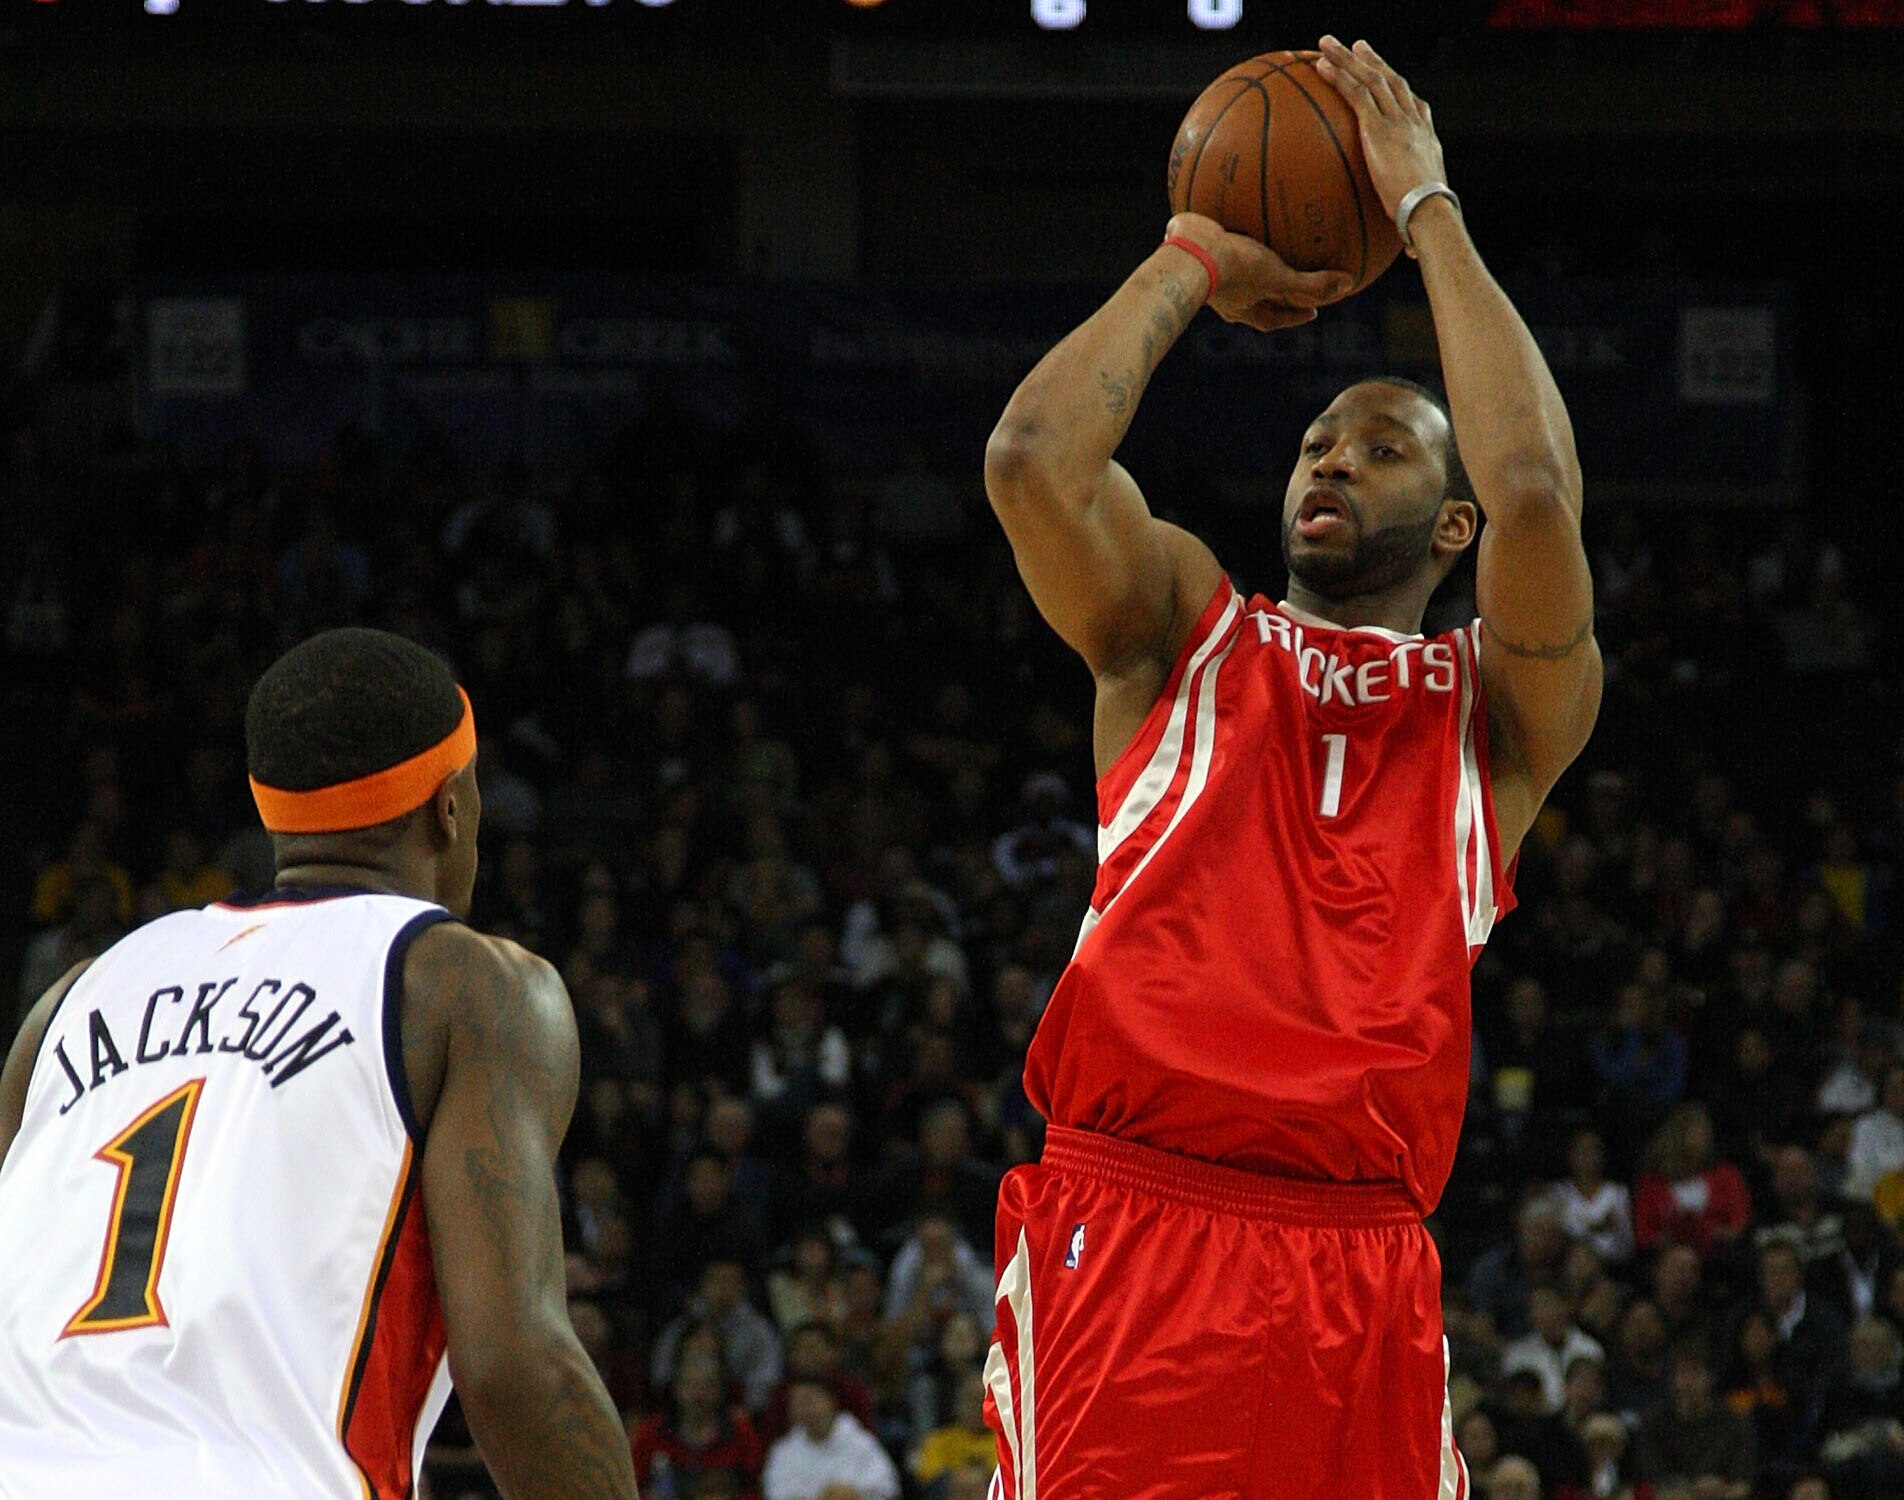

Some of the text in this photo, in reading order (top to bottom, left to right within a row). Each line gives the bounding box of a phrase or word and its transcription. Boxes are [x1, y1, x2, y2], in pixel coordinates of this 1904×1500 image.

[1319, 733, 1347, 818] 1
[53, 976, 355, 1117] JACKSON
[55, 1075, 207, 1343] 1
